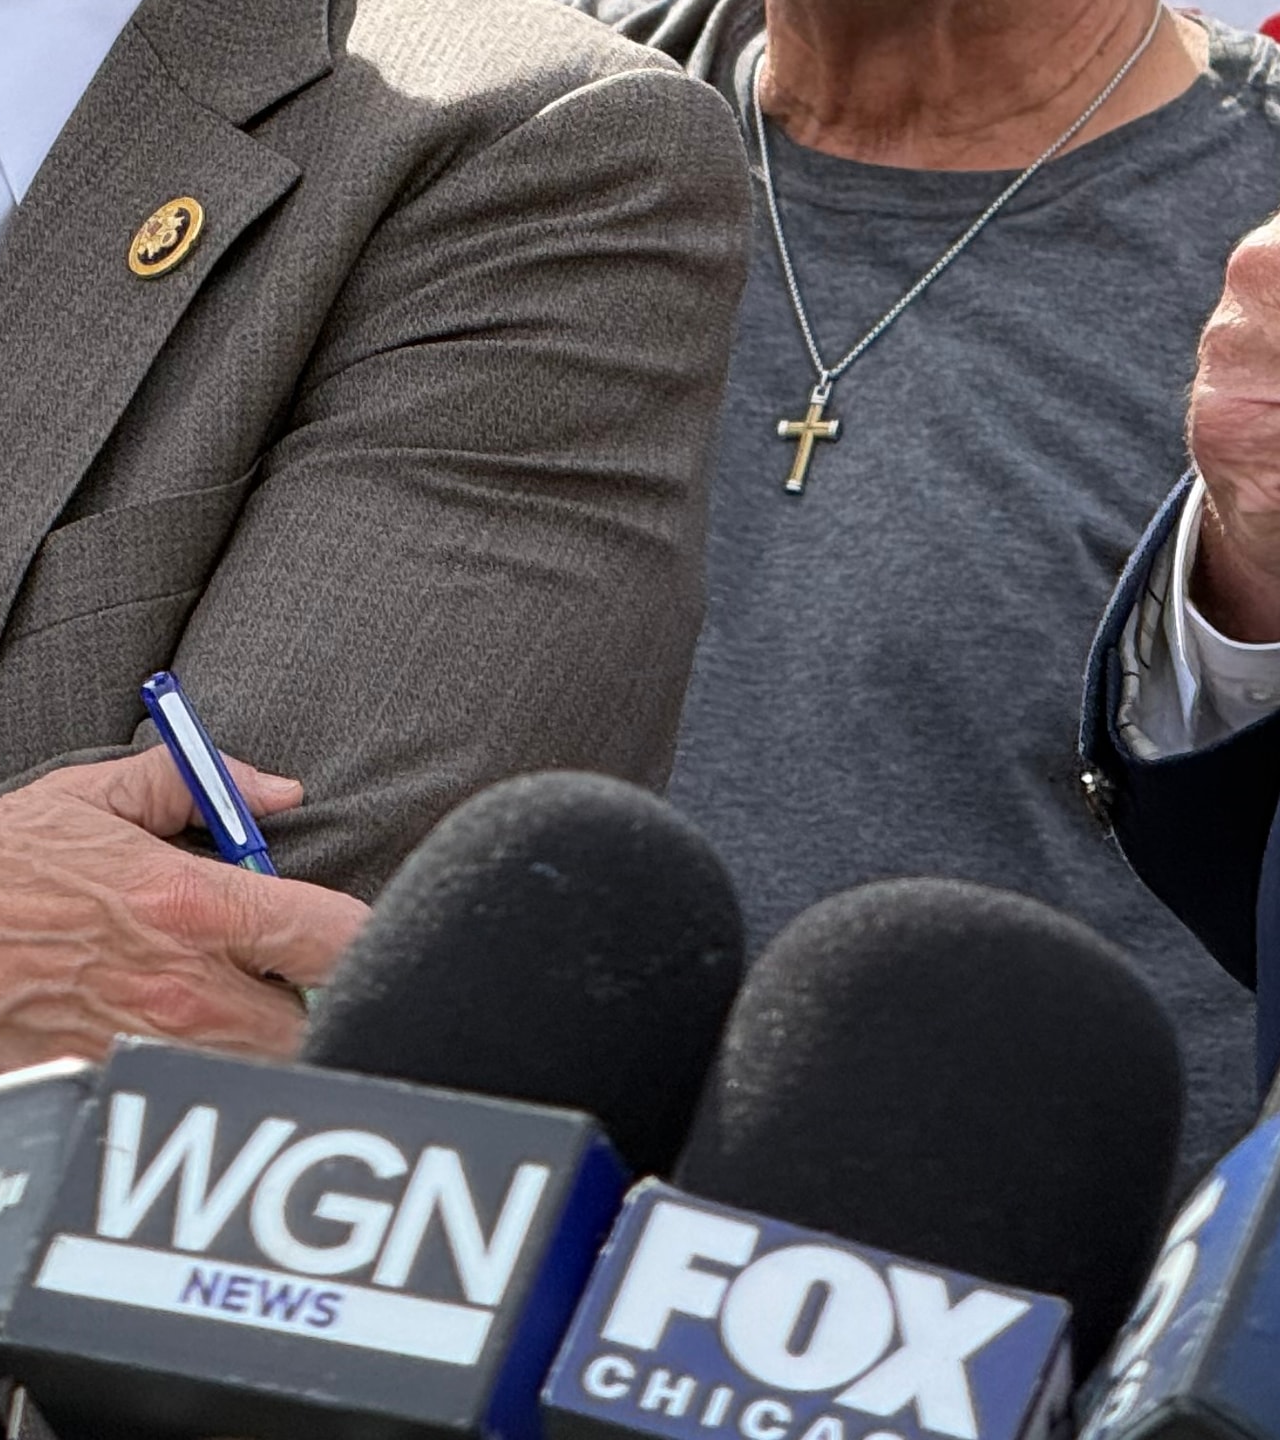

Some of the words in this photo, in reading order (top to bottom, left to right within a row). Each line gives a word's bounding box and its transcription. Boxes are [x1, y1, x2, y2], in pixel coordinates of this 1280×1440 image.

[96, 1092, 549, 1307] WGN
[180, 1266, 342, 1329] NEWS
[602, 1201, 1031, 1440] FOX
